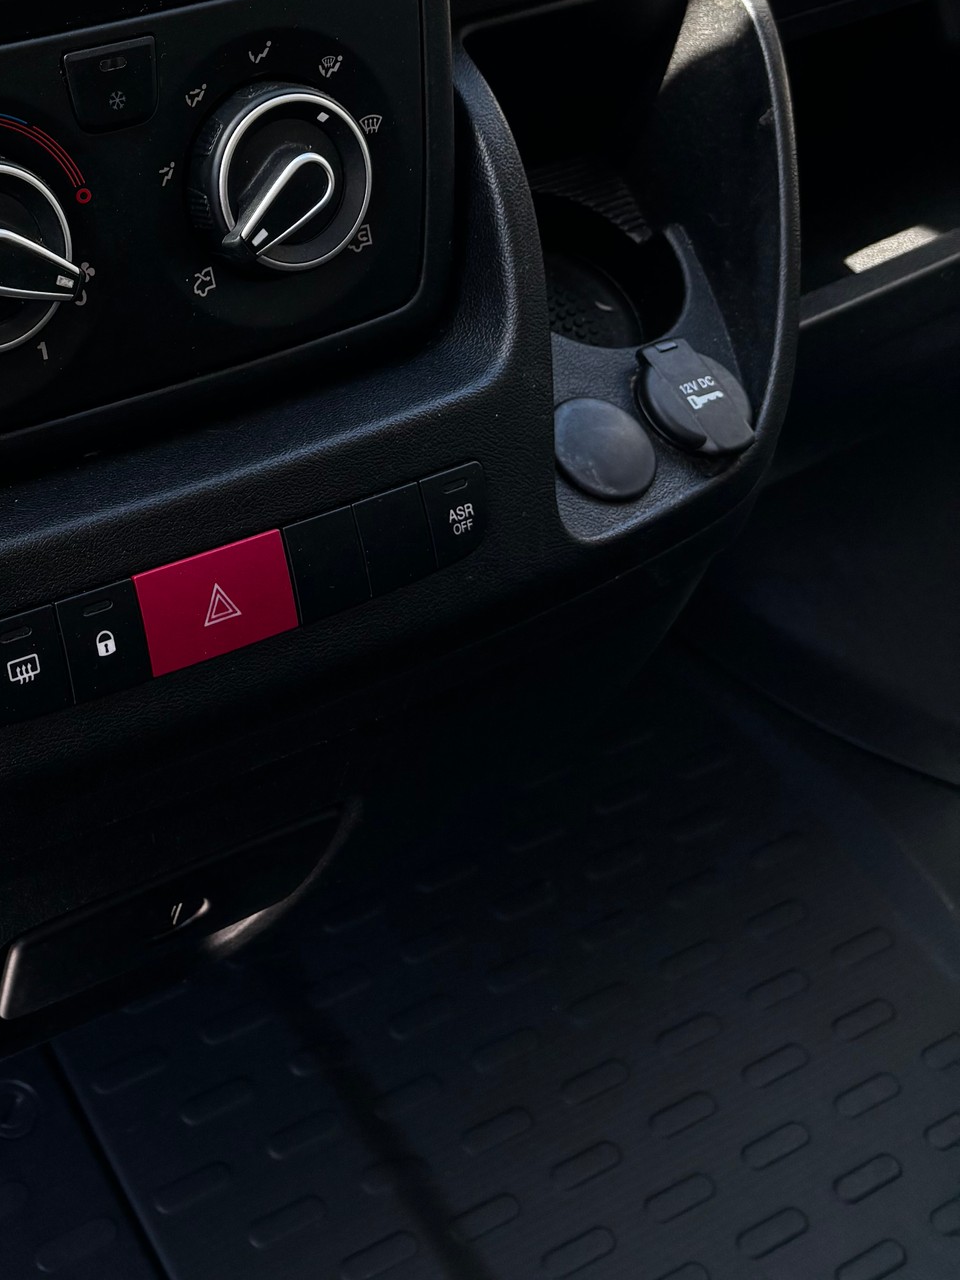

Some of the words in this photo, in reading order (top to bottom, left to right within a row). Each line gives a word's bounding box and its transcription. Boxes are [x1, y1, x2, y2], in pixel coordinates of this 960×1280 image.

[37, 342, 49, 360] 1
[679, 380, 697, 395] 12V
[698, 375, 715, 388] DC
[449, 503, 474, 523] ASR
[453, 518, 473, 535] OFF
